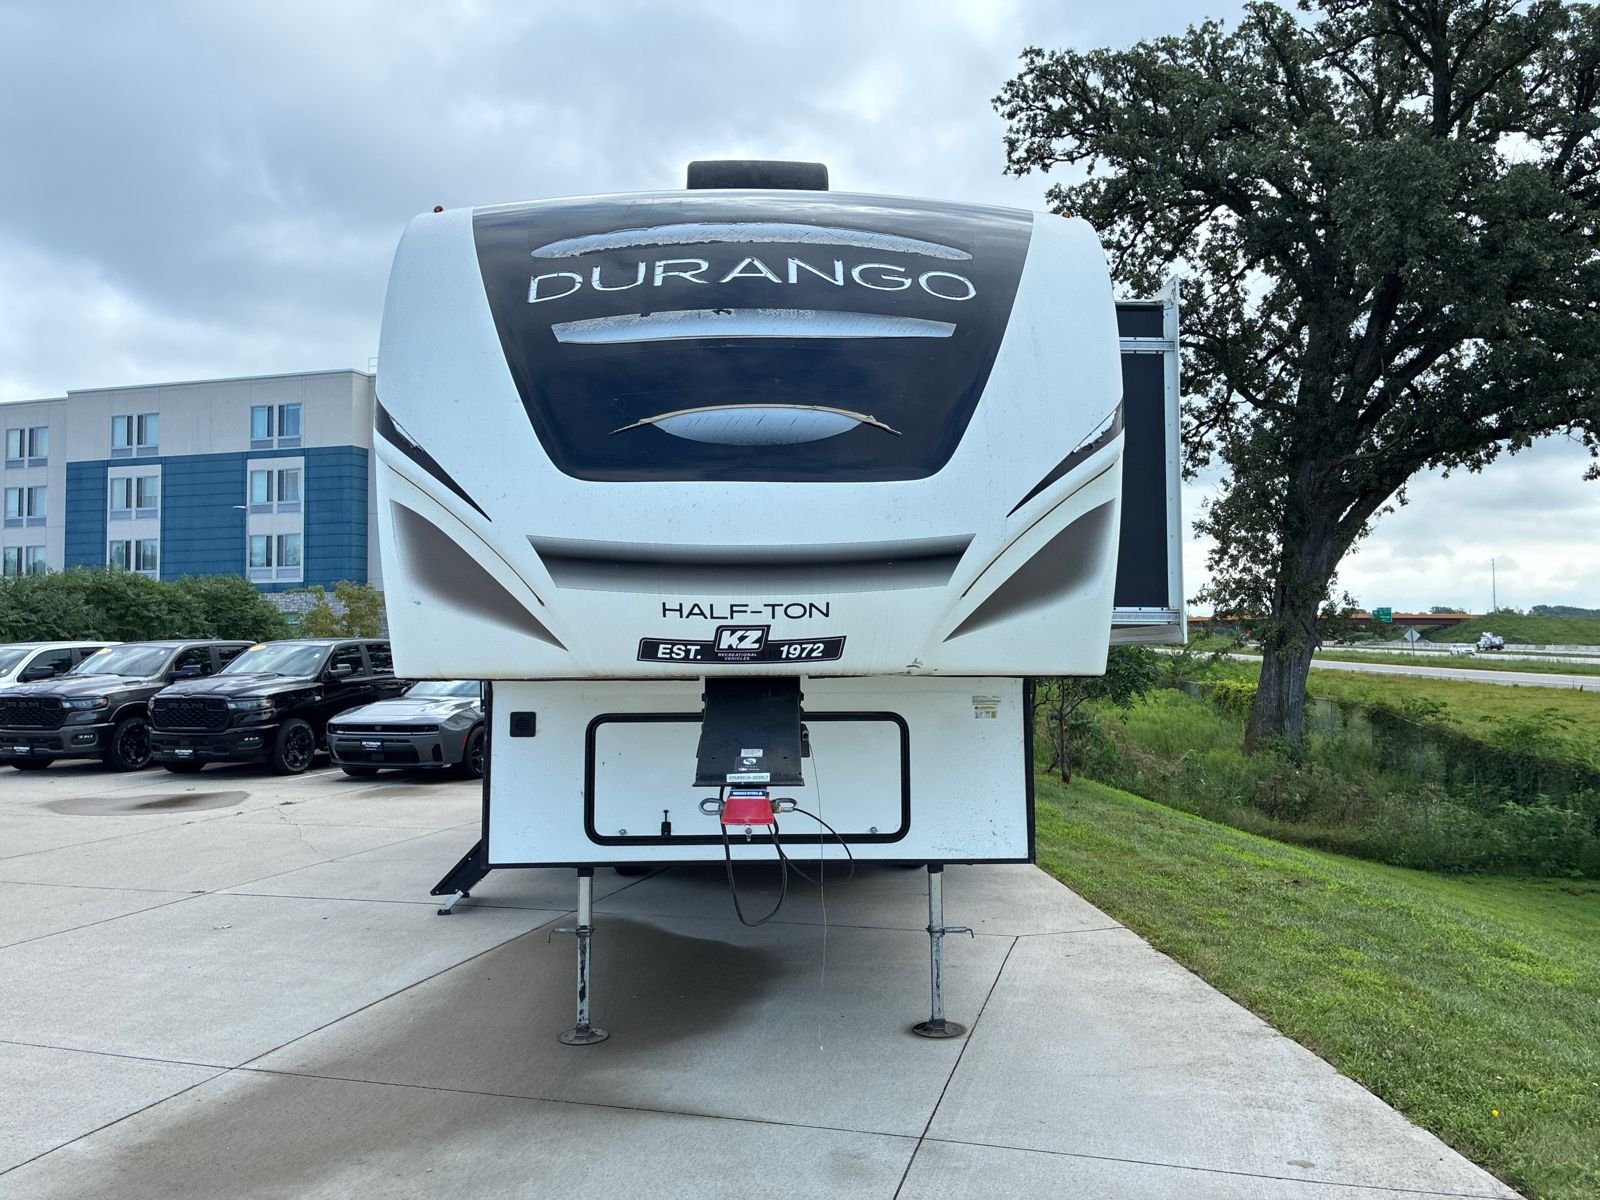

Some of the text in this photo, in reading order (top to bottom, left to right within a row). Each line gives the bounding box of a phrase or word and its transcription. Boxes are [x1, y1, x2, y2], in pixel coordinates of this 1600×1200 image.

[527, 256, 977, 304] DURANGO
[662, 602, 830, 620] HALF-TON
[719, 630, 763, 649] KZ
[657, 643, 825, 660] EST. 1972
